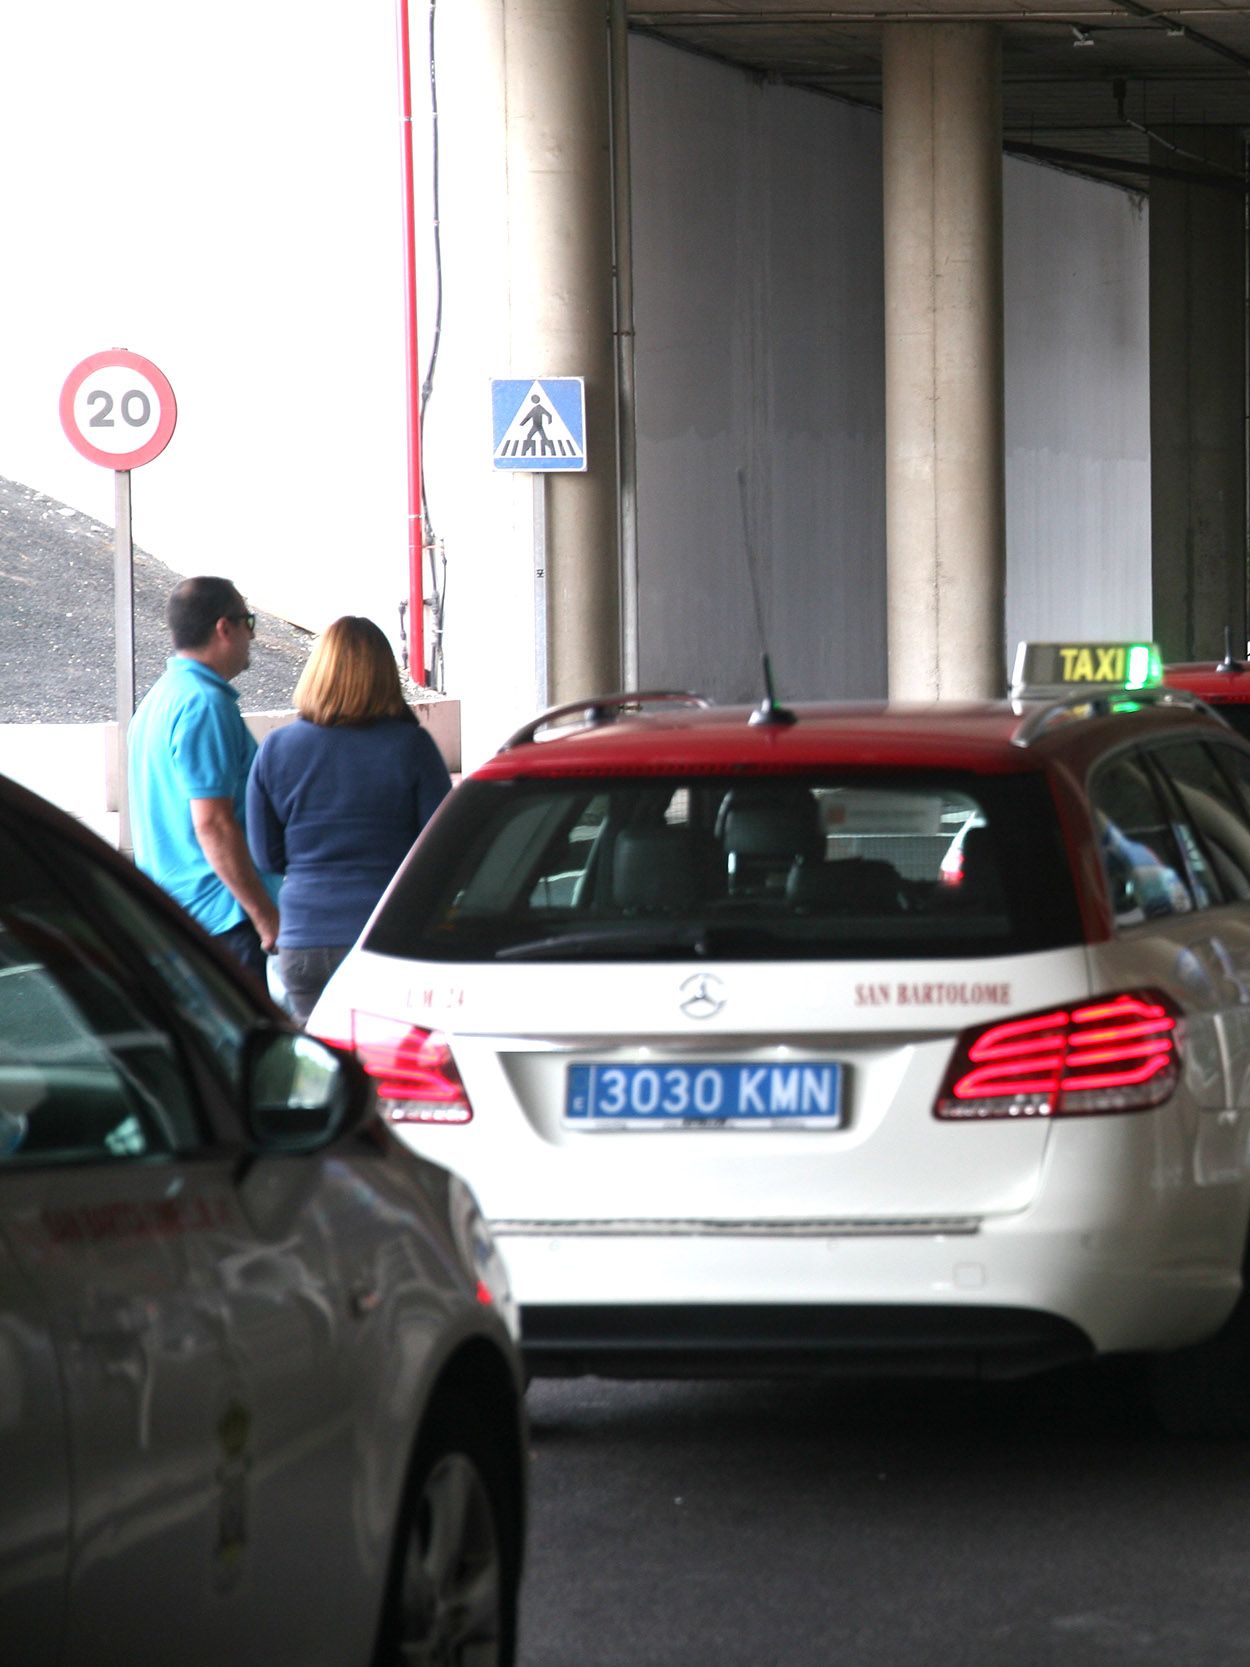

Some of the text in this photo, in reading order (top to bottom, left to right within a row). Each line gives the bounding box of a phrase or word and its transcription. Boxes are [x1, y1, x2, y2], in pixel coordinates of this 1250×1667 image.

[87, 389, 151, 427] 20
[1059, 648, 1125, 682] TAXI
[855, 983, 889, 1005] SAN
[600, 1068, 830, 1114] 3030 KMN
